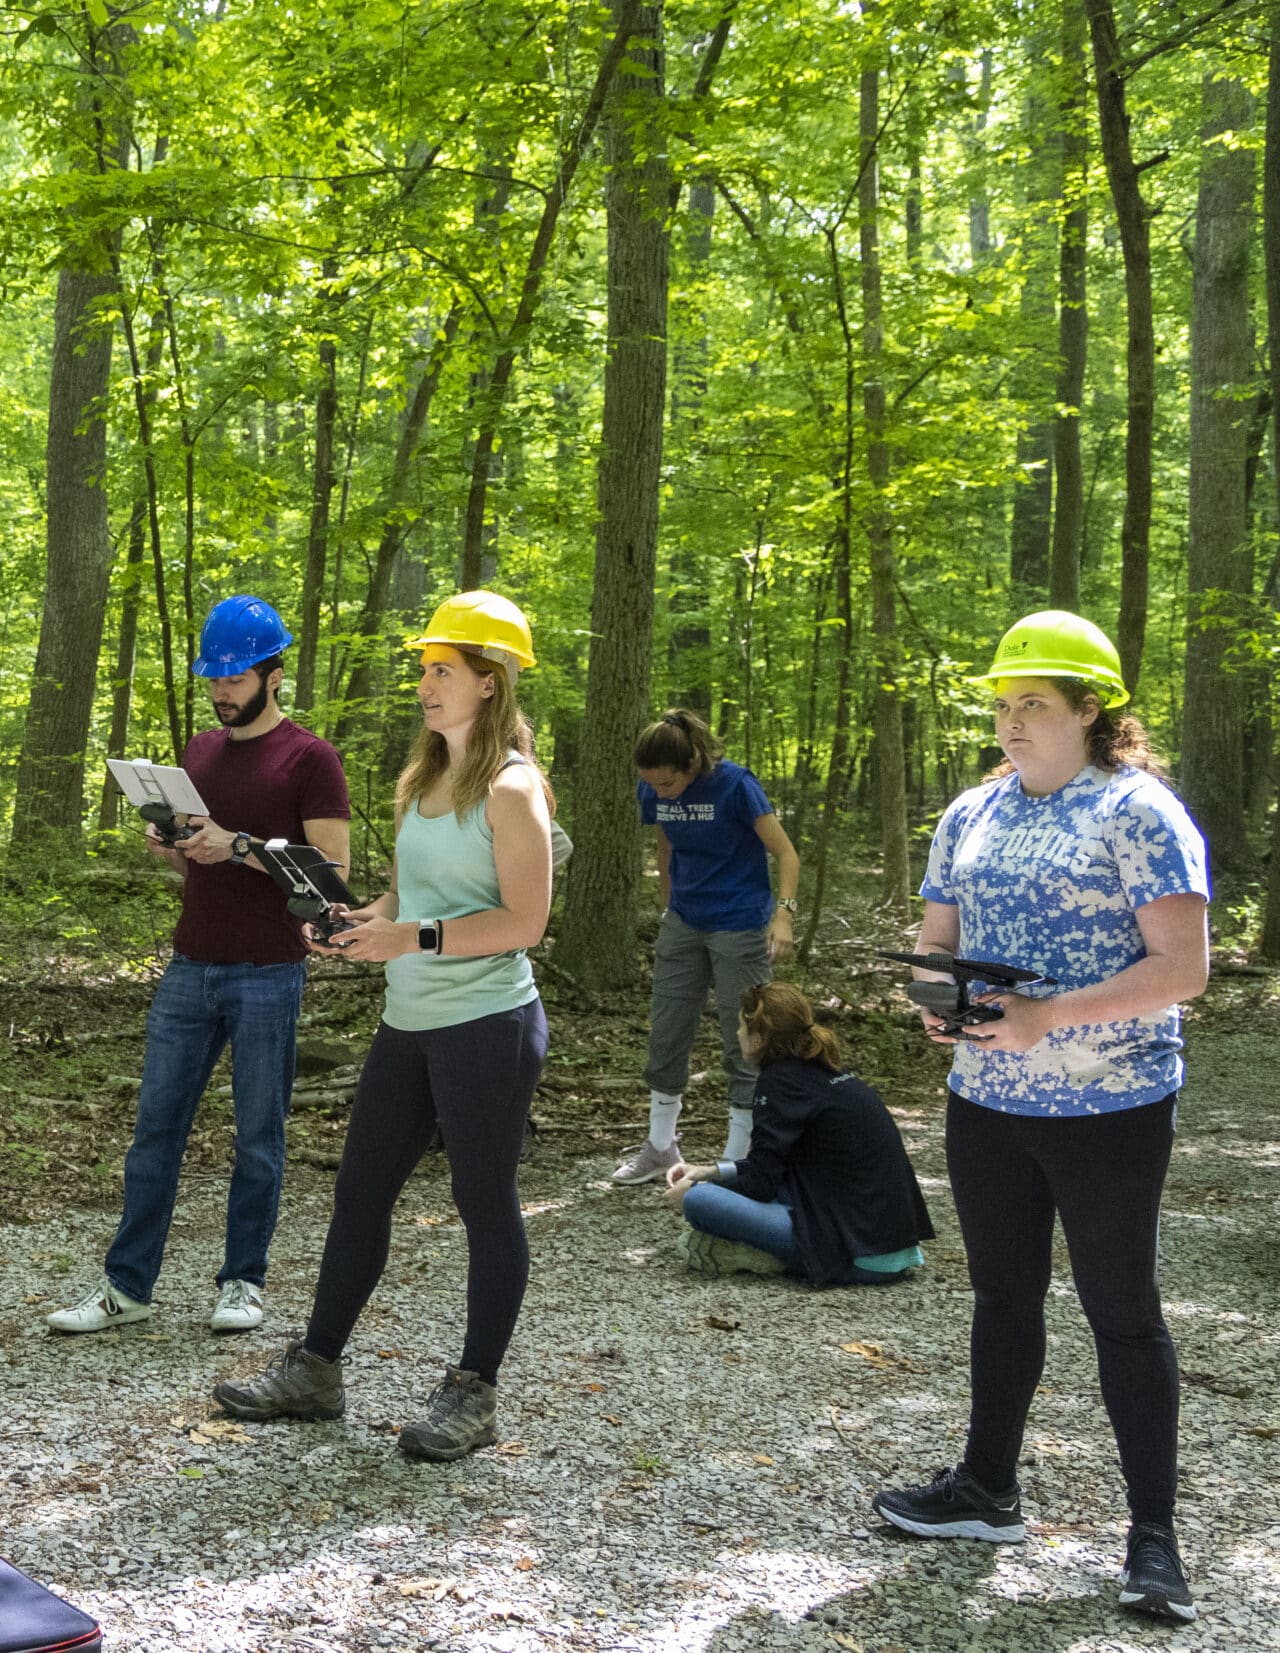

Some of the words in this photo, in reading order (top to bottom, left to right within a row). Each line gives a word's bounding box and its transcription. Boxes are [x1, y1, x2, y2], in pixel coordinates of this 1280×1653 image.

[669, 804, 685, 814] ALL
[686, 803, 715, 813] TREES
[689, 812, 697, 821] A
[697, 812, 715, 821] HUG
[1001, 828, 1091, 875] DEVILS
